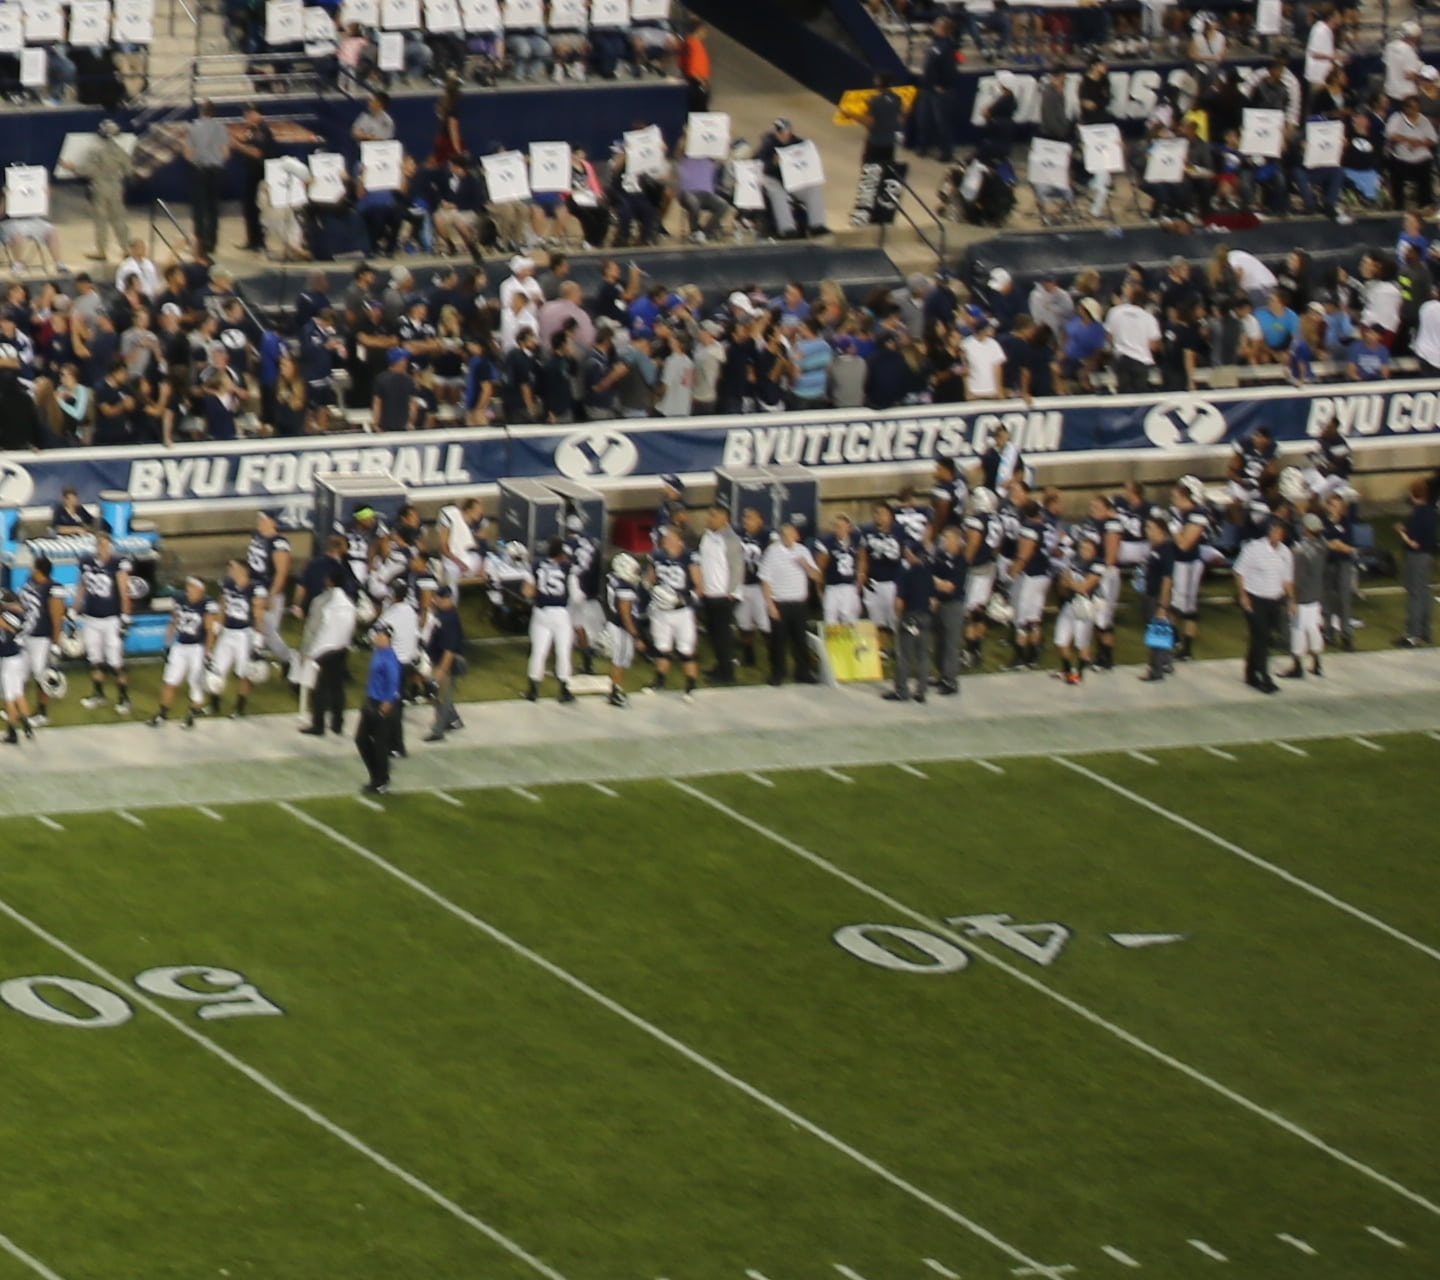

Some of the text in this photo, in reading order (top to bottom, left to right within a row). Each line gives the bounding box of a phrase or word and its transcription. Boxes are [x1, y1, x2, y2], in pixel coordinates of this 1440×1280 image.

[1306, 390, 1440, 438] BYU CO
[128, 457, 233, 503] BYU
[830, 908, 1076, 977] 40
